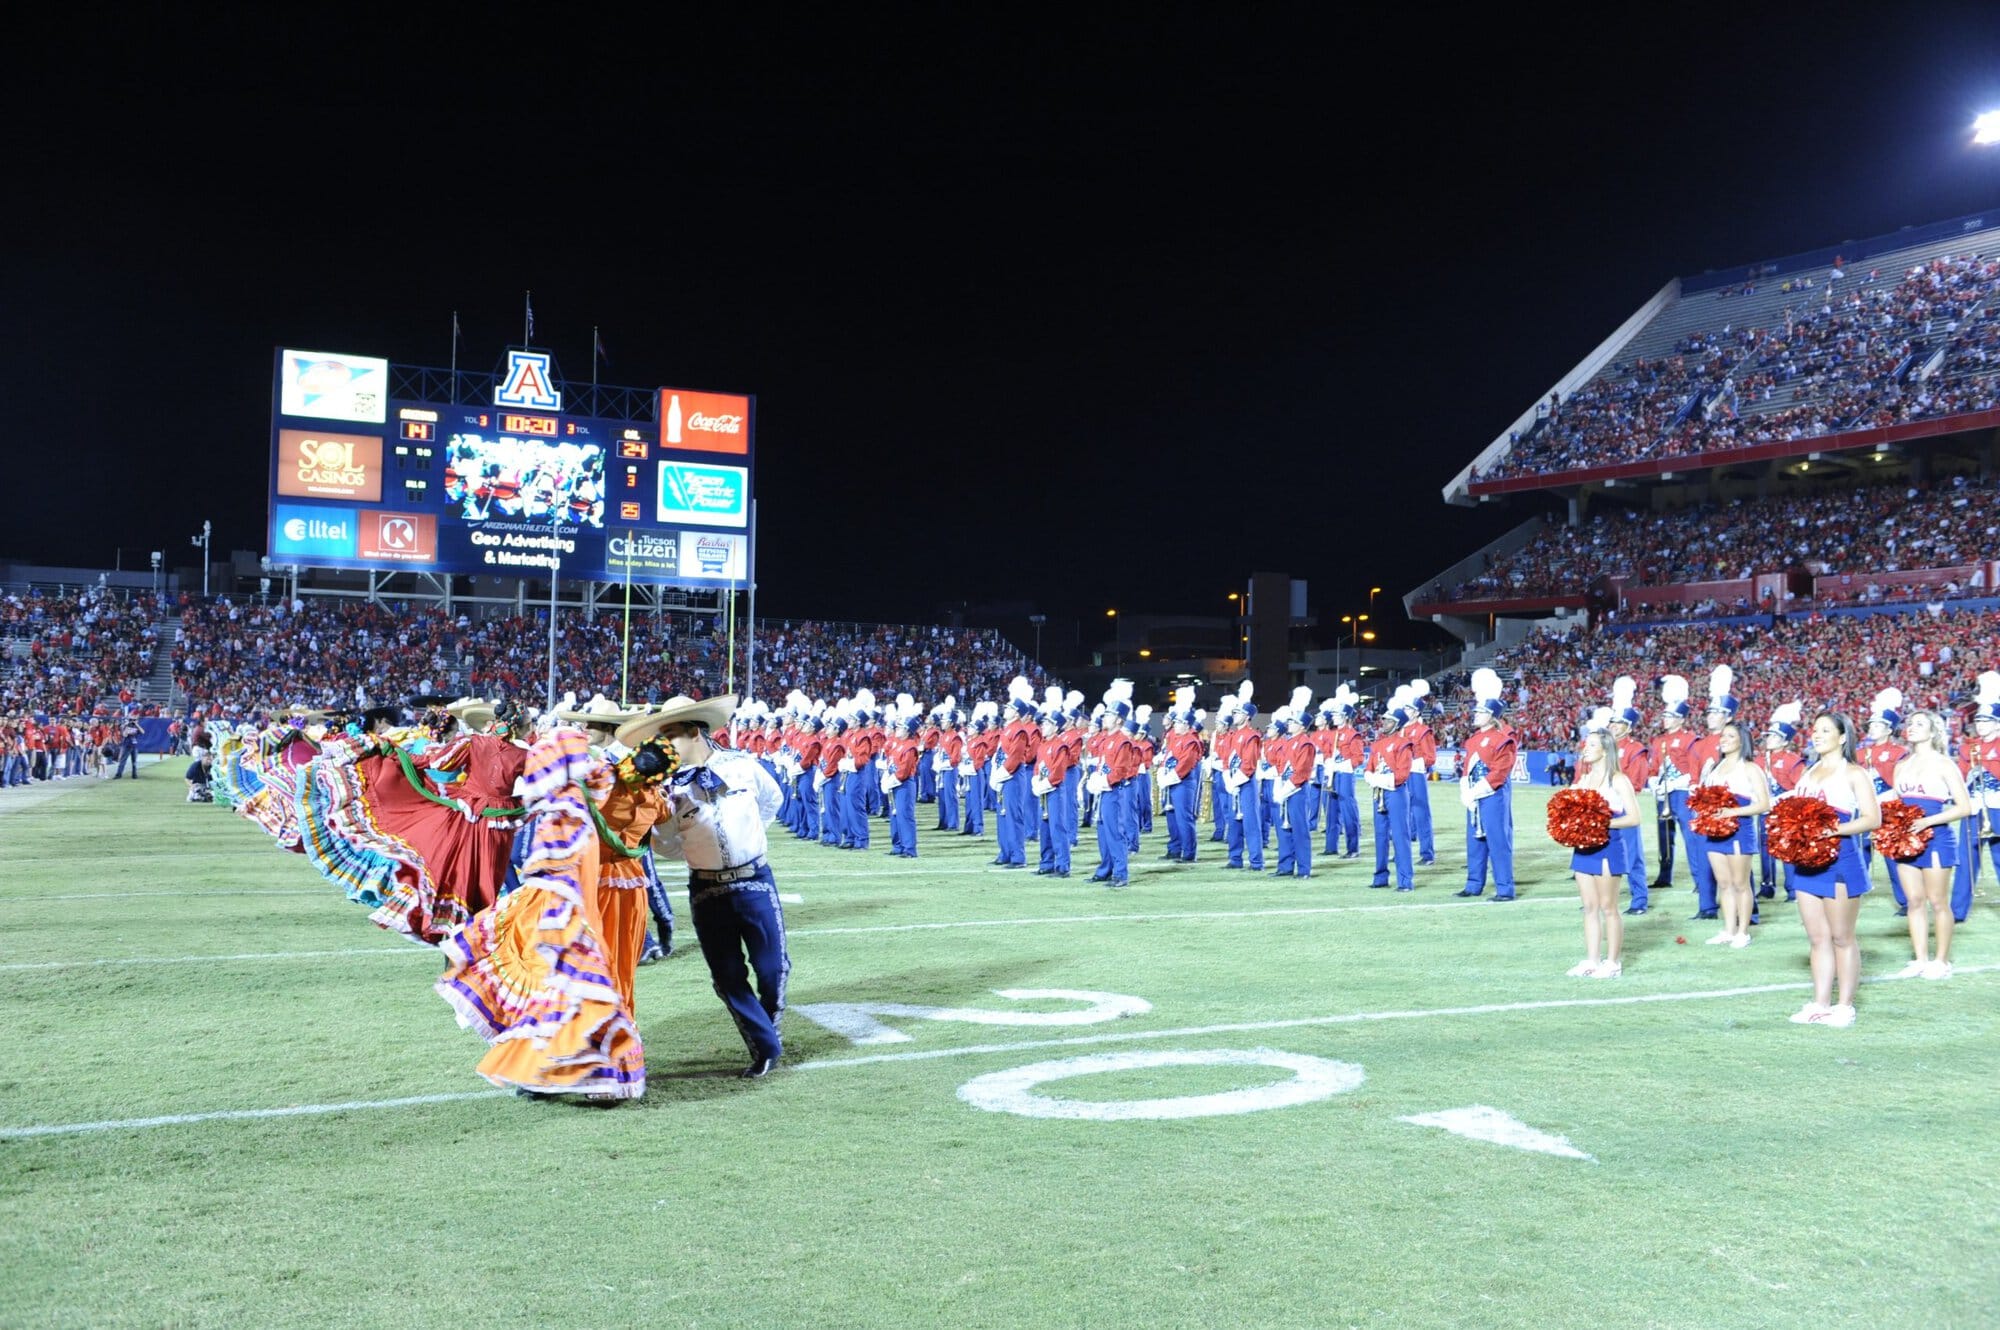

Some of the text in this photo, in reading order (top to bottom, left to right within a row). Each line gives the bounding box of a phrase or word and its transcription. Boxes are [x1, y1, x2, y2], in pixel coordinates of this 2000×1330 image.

[494, 350, 561, 411] A
[464, 415, 488, 427] TOL 3
[505, 415, 557, 435] 10:20
[567, 423, 590, 435] 3 TOL
[408, 423, 428, 439] 14
[298, 439, 365, 472] SOL
[623, 442, 647, 458] 24
[297, 468, 365, 486] CASINOS
[627, 474, 636, 487] 3
[622, 504, 638, 517] 25
[471, 531, 575, 553] Geo Advertising
[608, 538, 677, 558] Citizen
[641, 535, 676, 546] Tucson
[484, 550, 560, 570] & Marketing
